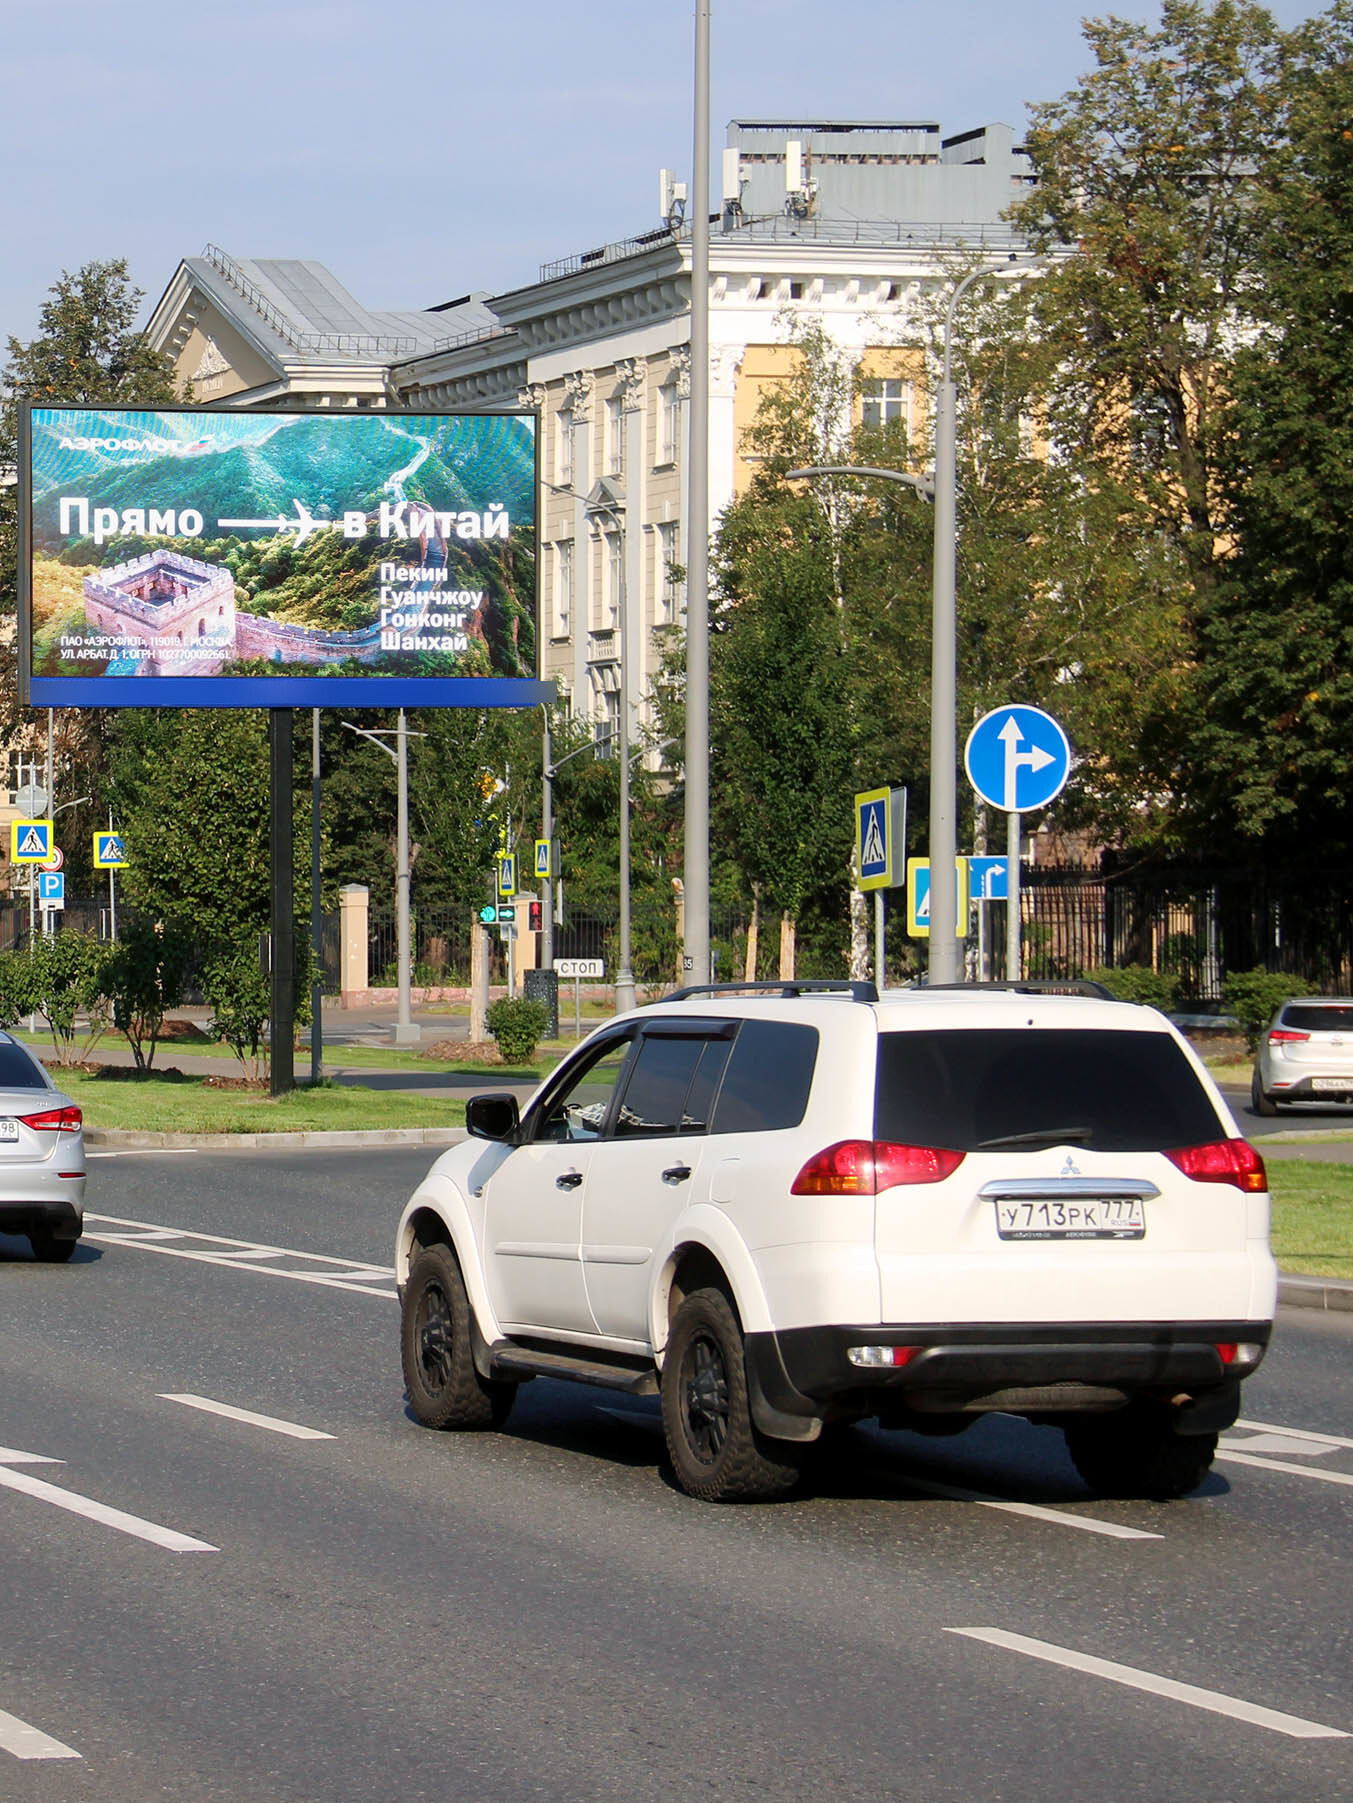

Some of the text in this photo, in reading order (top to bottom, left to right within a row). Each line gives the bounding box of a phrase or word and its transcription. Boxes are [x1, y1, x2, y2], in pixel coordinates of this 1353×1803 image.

[59, 437, 182, 452] АЭРОФЛОТ
[60, 497, 509, 544] Прямо в Китай
[381, 562, 448, 581] Пекин
[381, 586, 483, 609] Гуанчжоу
[381, 609, 467, 627] Гонконг
[60, 636, 82, 646] ПАО
[381, 632, 468, 650] Шанхай
[560, 962, 597, 974] СТОП
[1006, 1200, 1135, 1226] У713РК 777
